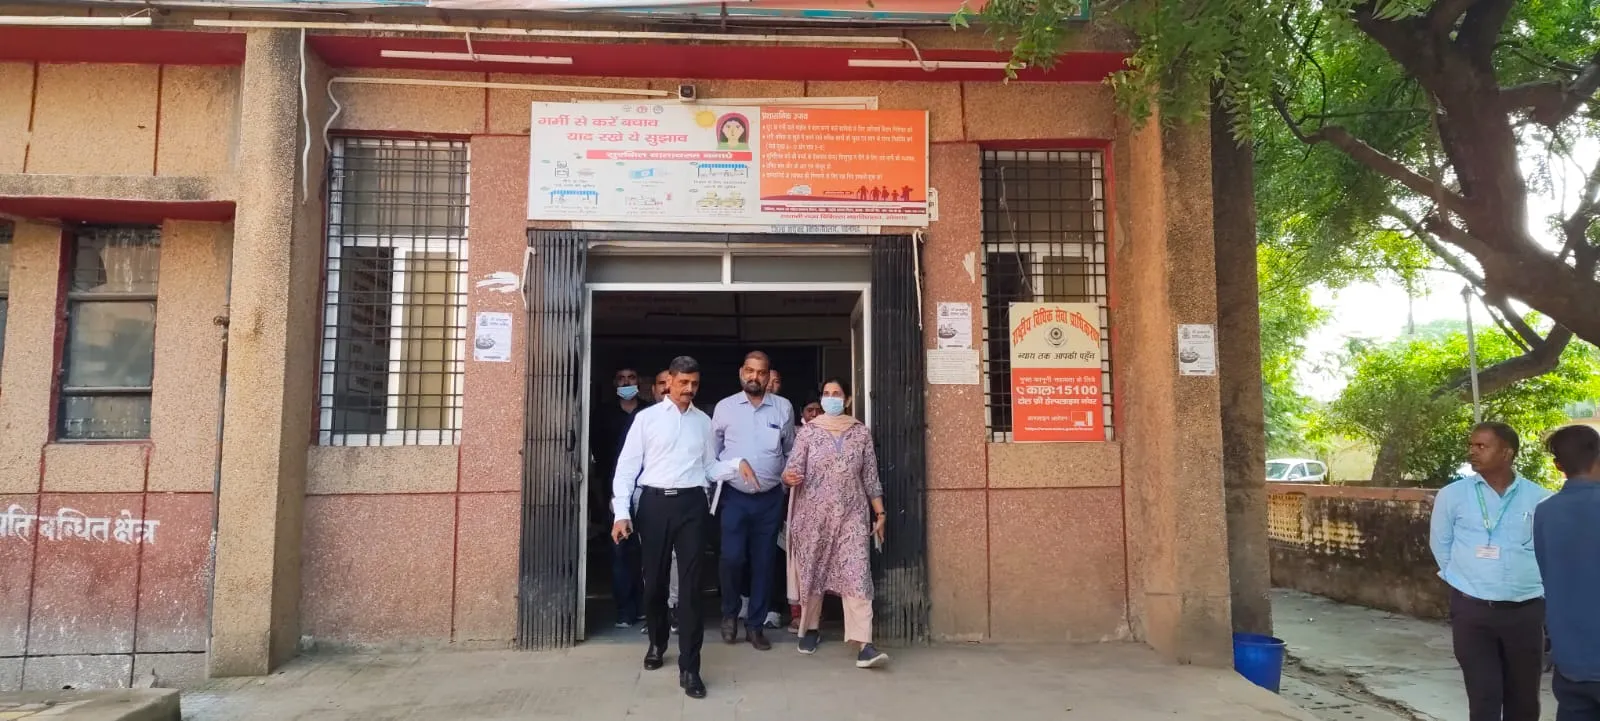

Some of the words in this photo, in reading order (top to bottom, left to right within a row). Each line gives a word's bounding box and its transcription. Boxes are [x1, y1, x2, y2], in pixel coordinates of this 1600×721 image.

[538, 114, 569, 126] गर्मी
[574, 115, 587, 127] से
[592, 116, 618, 127] करें
[621, 118, 658, 127] बचाव
[567, 132, 593, 141] याद
[628, 131, 640, 142] ये
[645, 133, 688, 146] सुझाव
[1012, 317, 1031, 348] राष्ट्रीय
[1033, 307, 1053, 327] विधिक
[1055, 306, 1067, 324] सेवा
[1069, 311, 1100, 348] प्राधिकरण
[1017, 352, 1035, 360] न्याय
[1037, 352, 1051, 360] तक
[1054, 350, 1077, 360] आपकी
[113, 509, 161, 544] क्षेत्र
